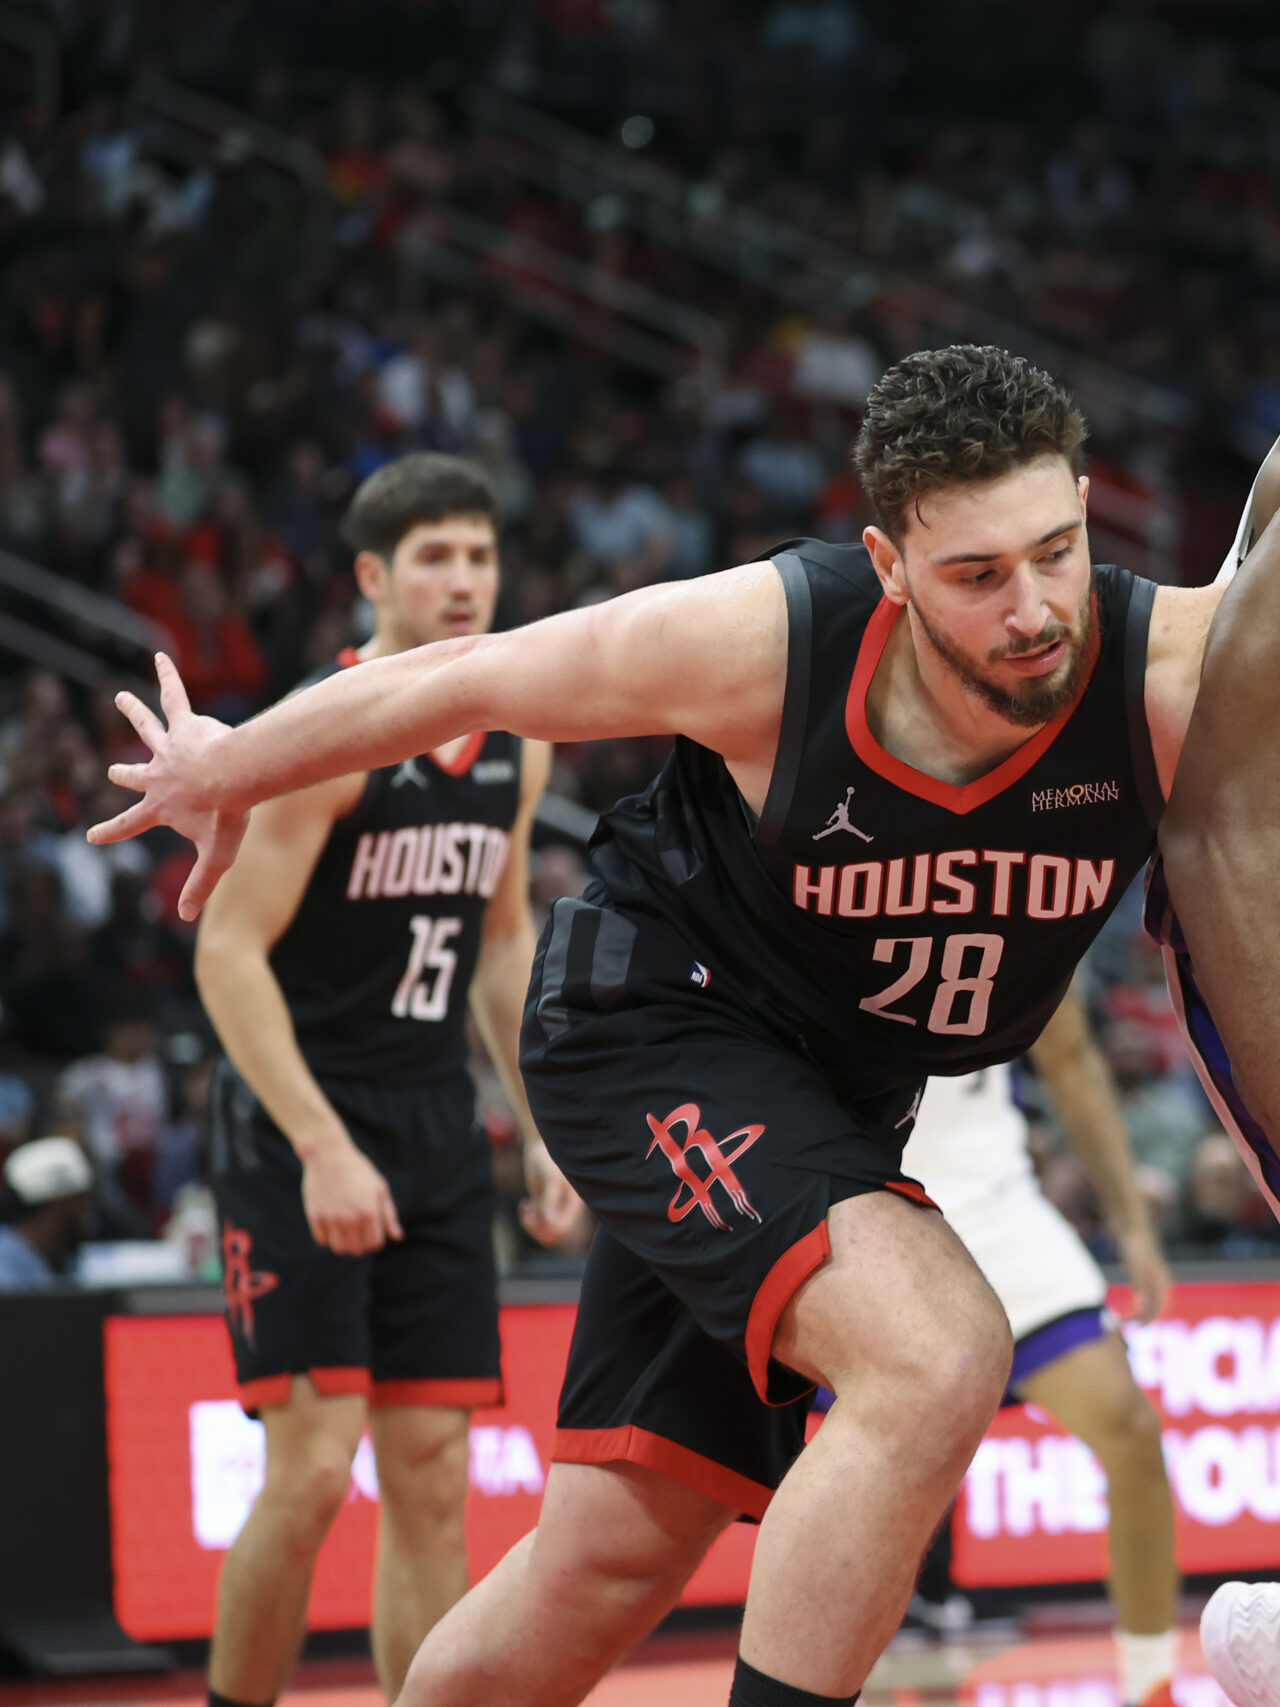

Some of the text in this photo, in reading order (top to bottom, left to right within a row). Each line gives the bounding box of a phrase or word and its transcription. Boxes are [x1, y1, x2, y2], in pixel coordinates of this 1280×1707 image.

[1031, 789, 1119, 812] HERMANN
[1032, 780, 1120, 801] MEMORIAL
[347, 822, 512, 900] HOUSTO
[793, 849, 1116, 920] HOUSTON
[391, 914, 463, 1022] 15
[858, 933, 1004, 1036] 28
[964, 1436, 1109, 1539] THE
